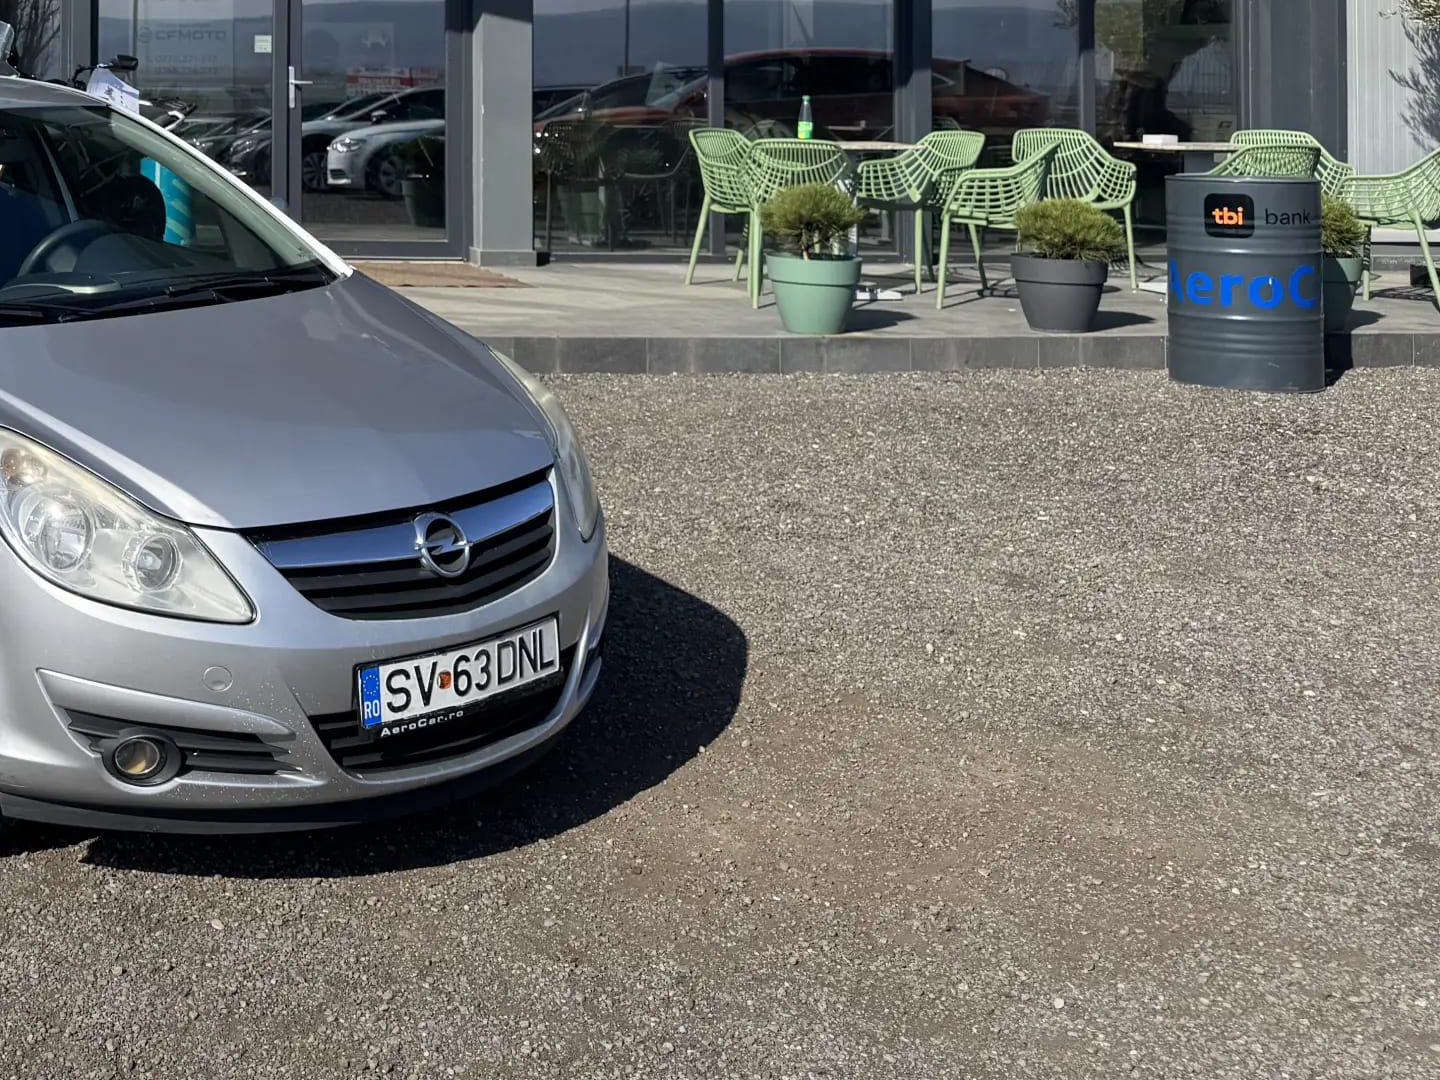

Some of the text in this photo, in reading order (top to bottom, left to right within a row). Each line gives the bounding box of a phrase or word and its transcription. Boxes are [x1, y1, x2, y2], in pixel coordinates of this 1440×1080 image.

[155, 30, 226, 41] CFMOTO
[1212, 206, 1311, 225] tbi bank
[364, 699, 380, 719] RO
[380, 710, 464, 738] AeroCar.ro
